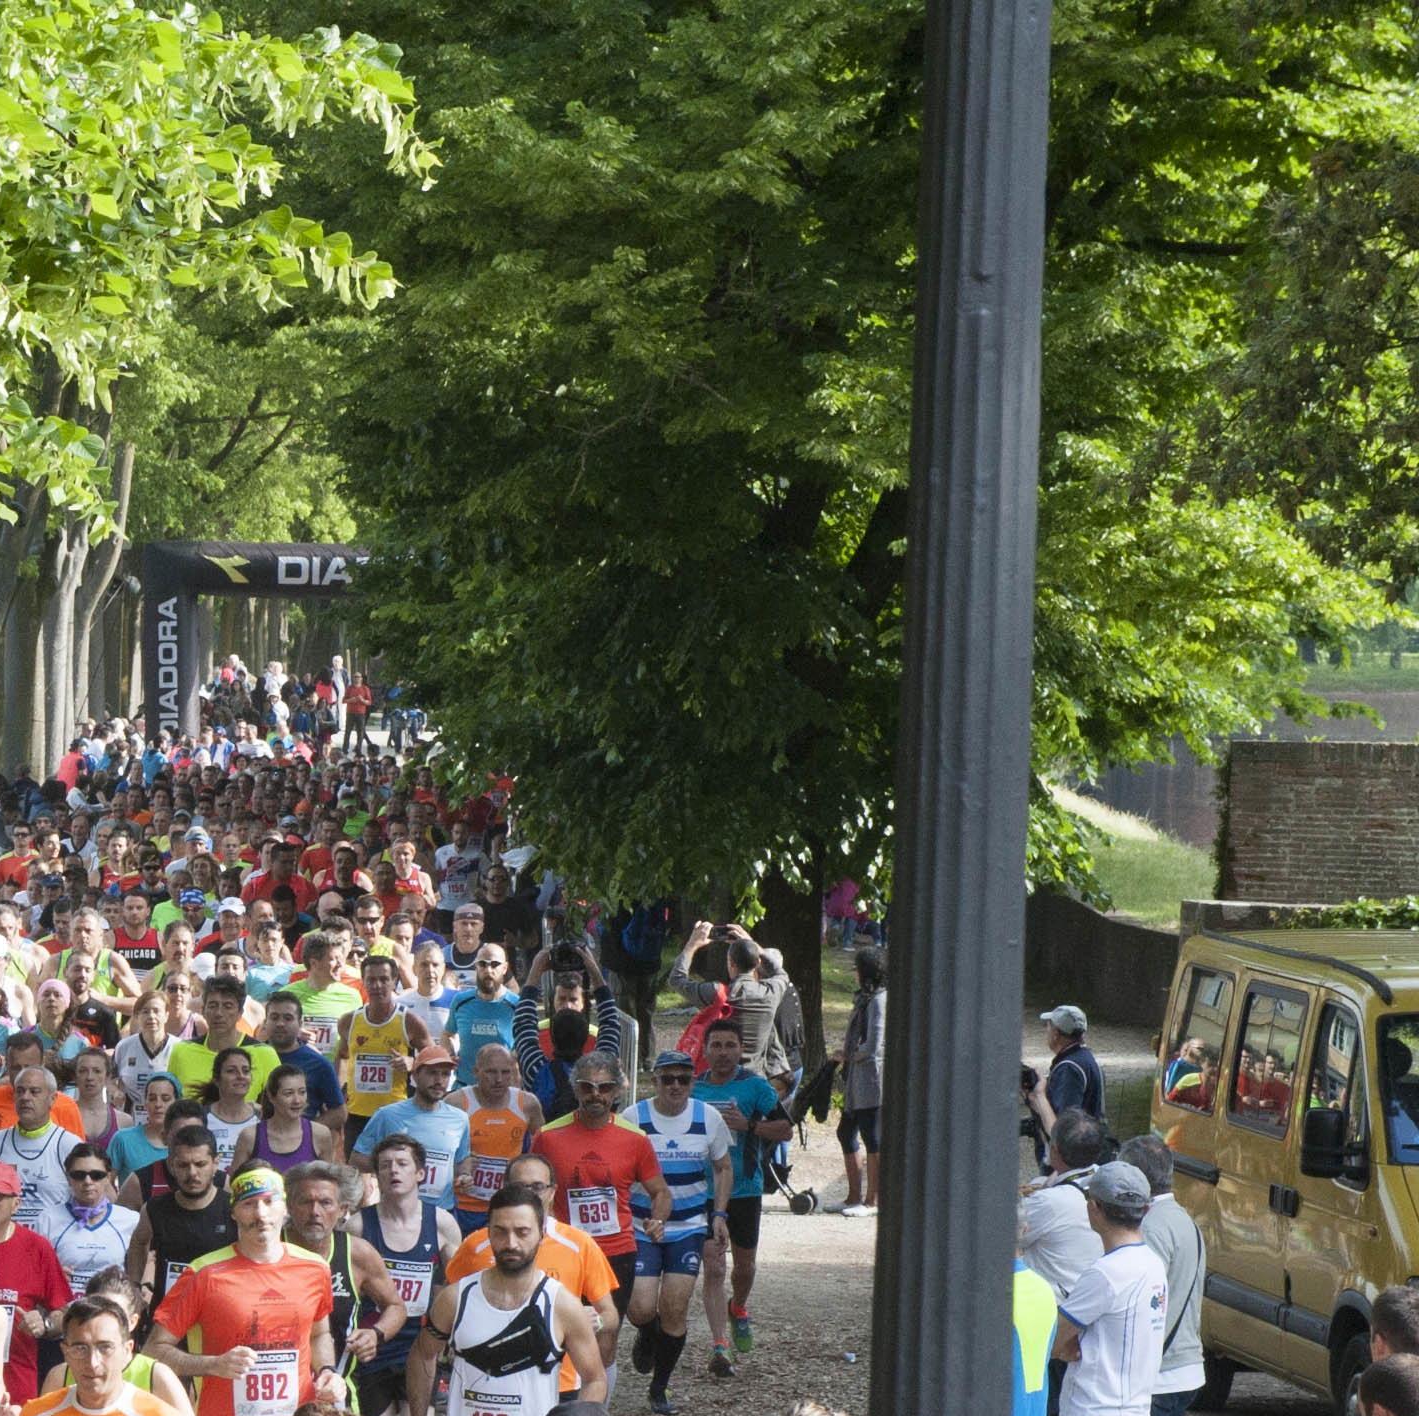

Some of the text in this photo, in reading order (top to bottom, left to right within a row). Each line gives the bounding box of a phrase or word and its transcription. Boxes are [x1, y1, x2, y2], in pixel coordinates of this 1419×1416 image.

[278, 556, 353, 585] DIA
[118, 948, 157, 960] CHICAGO
[361, 1066, 386, 1083] 826
[474, 1170, 505, 1190] 039
[578, 1201, 610, 1224] 639
[245, 1373, 288, 1401] 892
[476, 1393, 520, 1404] DIADORA
